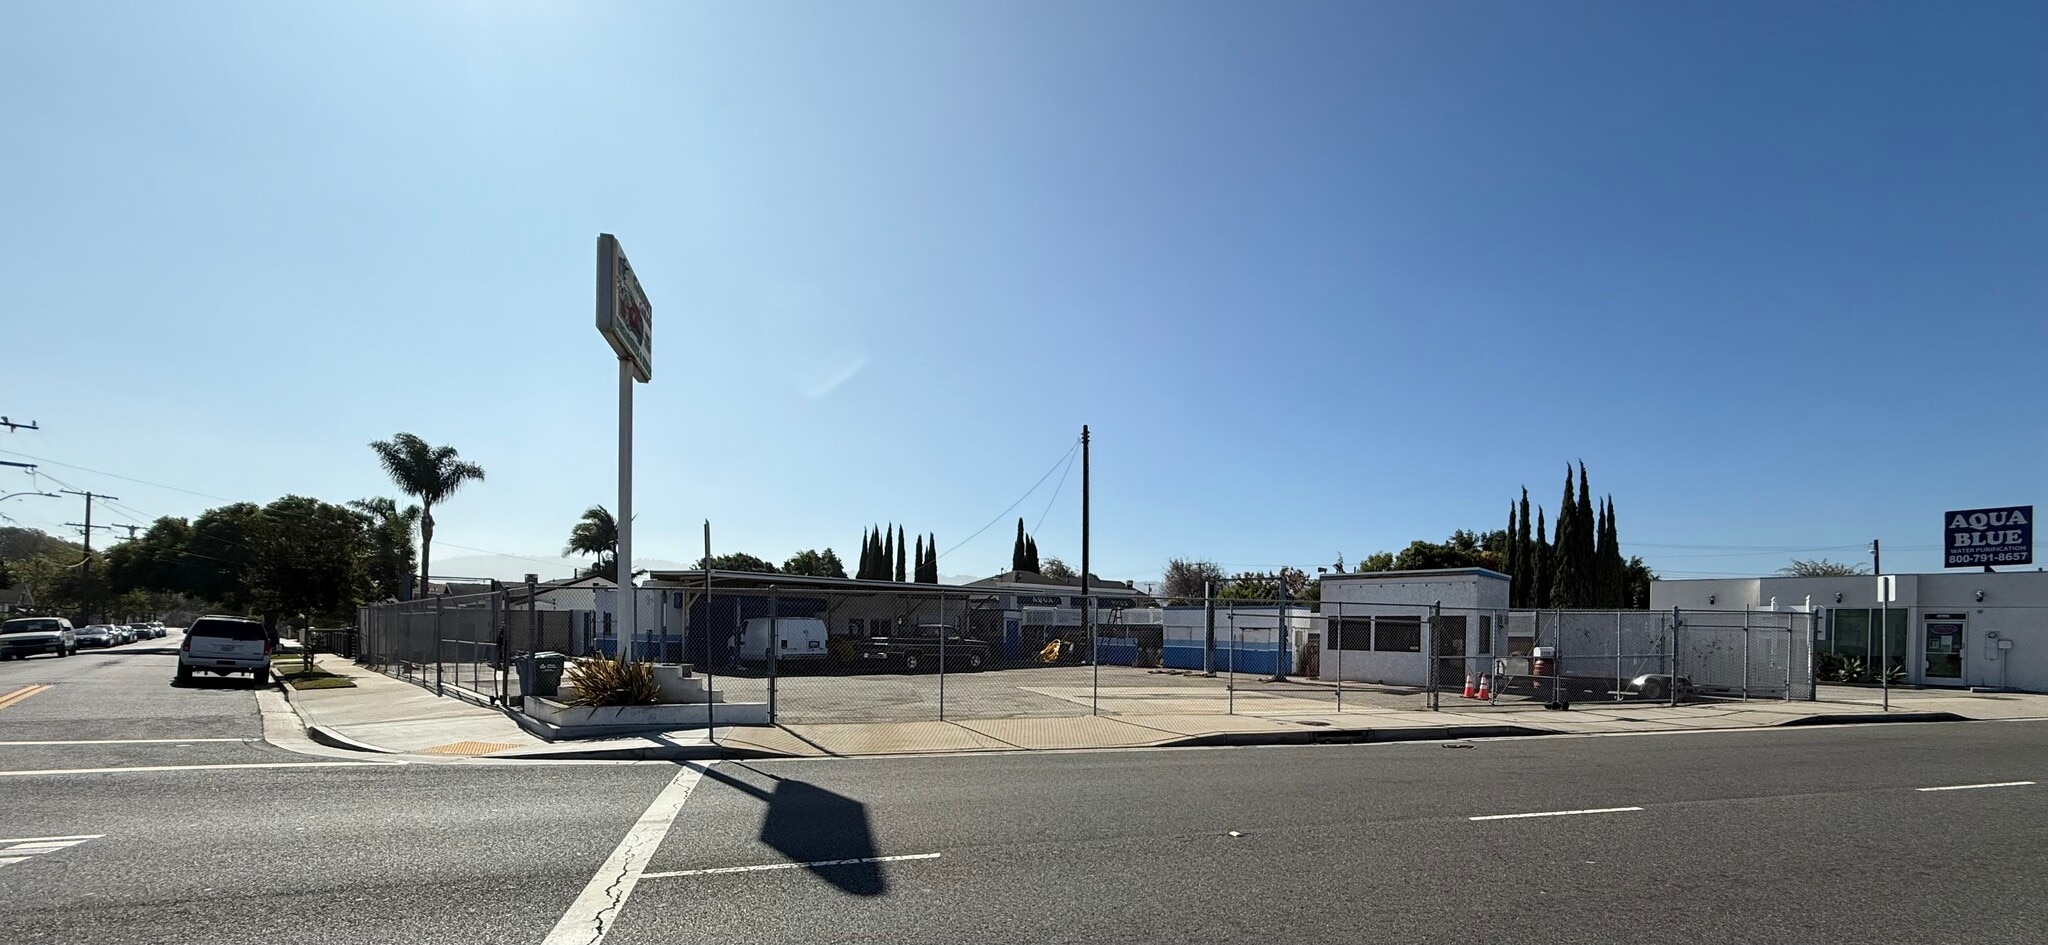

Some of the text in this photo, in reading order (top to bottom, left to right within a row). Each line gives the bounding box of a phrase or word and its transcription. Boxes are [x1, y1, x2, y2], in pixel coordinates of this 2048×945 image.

[1948, 510, 2028, 530] AQUA
[1953, 529, 2023, 547] BLUE
[1975, 545, 2027, 553] PURIFICATION
[1948, 552, 2028, 564] 800-791-8657
[1032, 596, 1054, 604] AQUA
